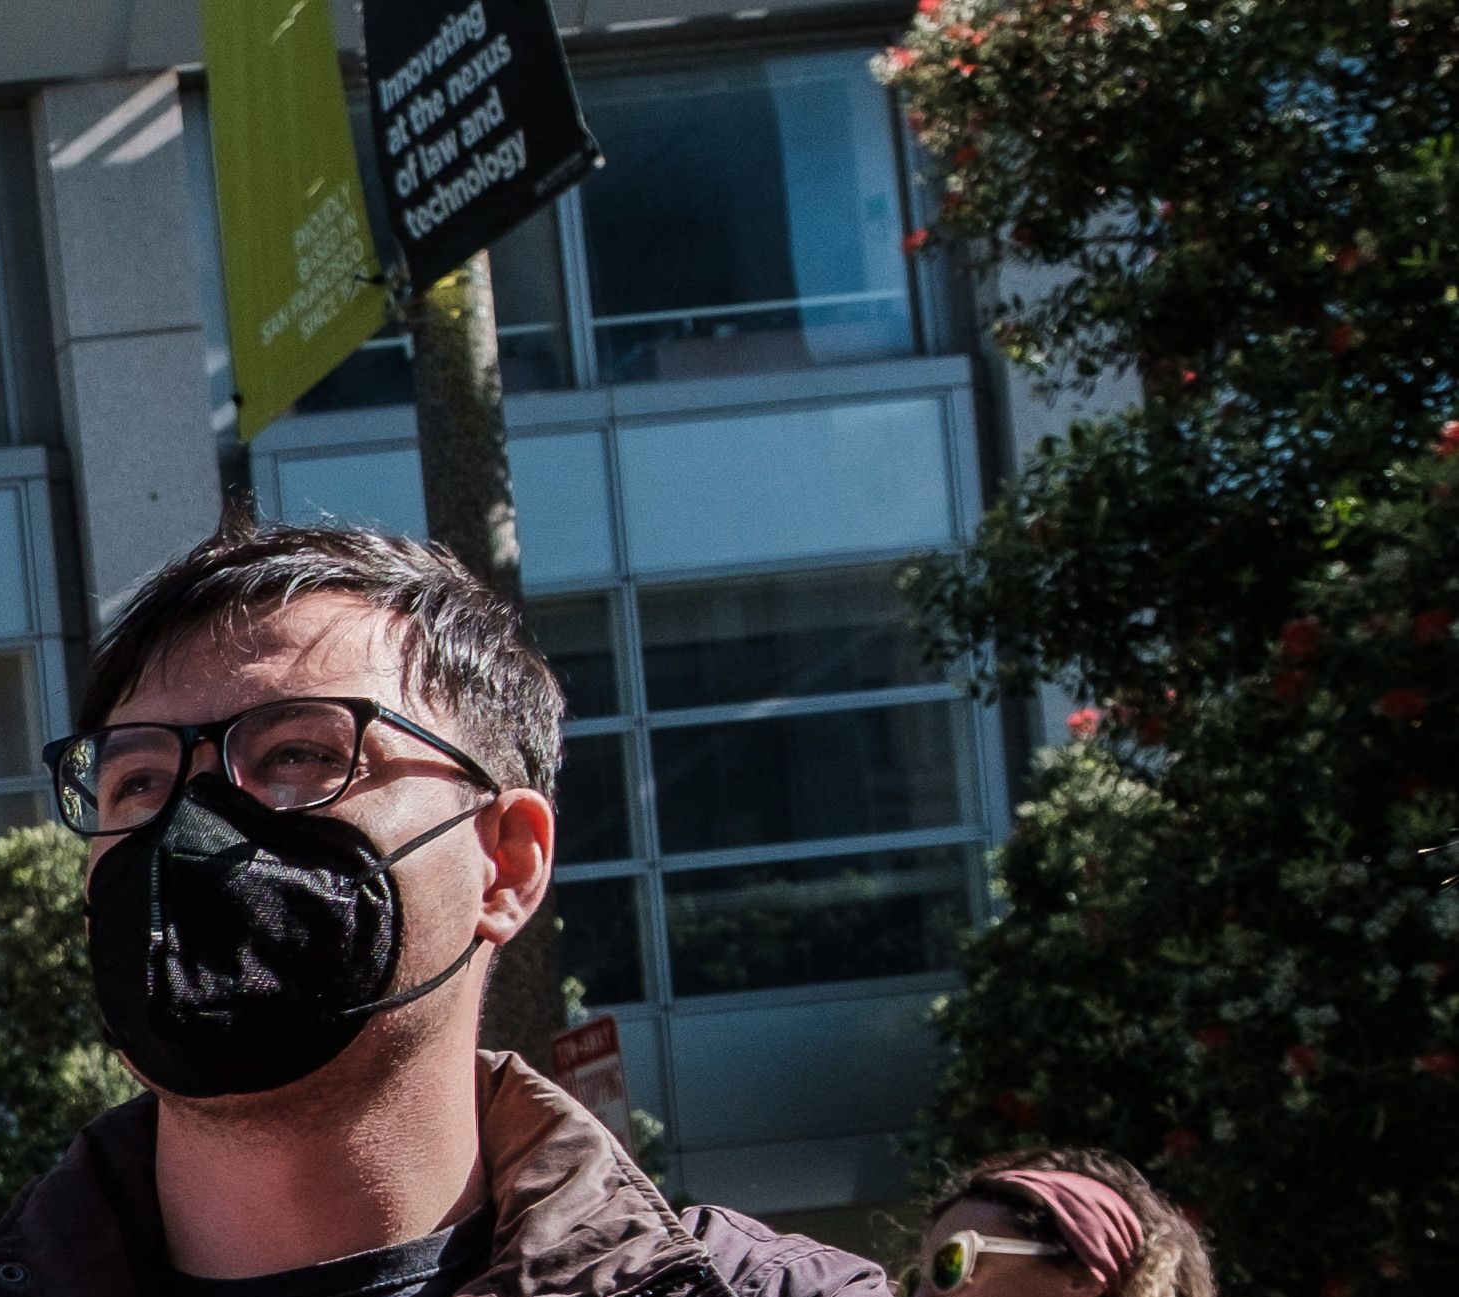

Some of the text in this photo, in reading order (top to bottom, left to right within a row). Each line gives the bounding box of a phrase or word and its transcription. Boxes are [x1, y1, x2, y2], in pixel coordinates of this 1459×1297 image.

[378, 0, 487, 113] Innovating
[386, 34, 512, 156] at the nexus
[395, 86, 505, 197] of law and
[402, 129, 527, 240] technology
